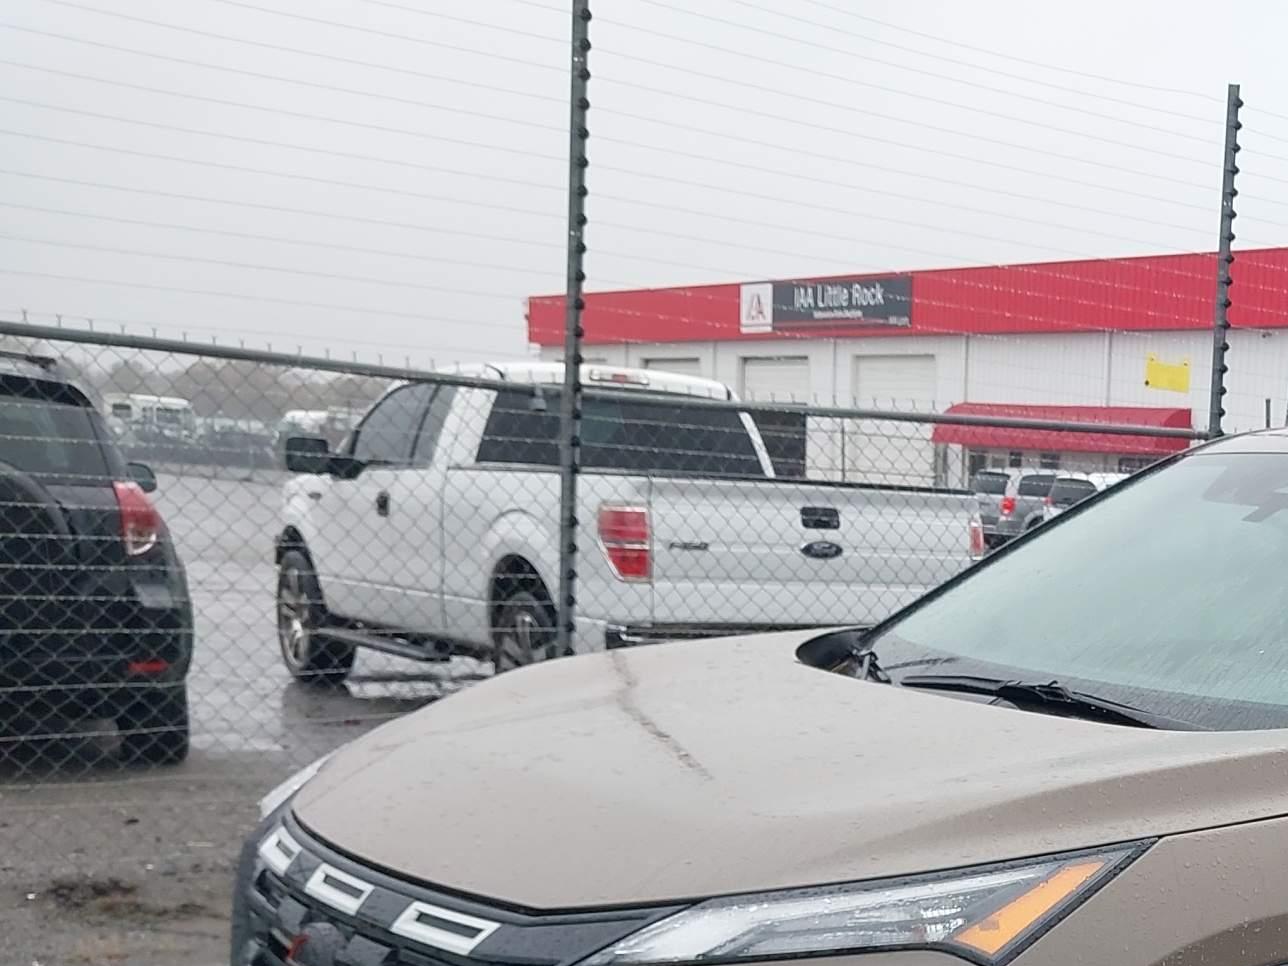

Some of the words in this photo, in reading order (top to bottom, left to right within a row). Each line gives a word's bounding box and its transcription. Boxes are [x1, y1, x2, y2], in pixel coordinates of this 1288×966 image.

[794, 287, 815, 309] IAA
[817, 284, 849, 308] Little
[852, 282, 885, 306] Rock
